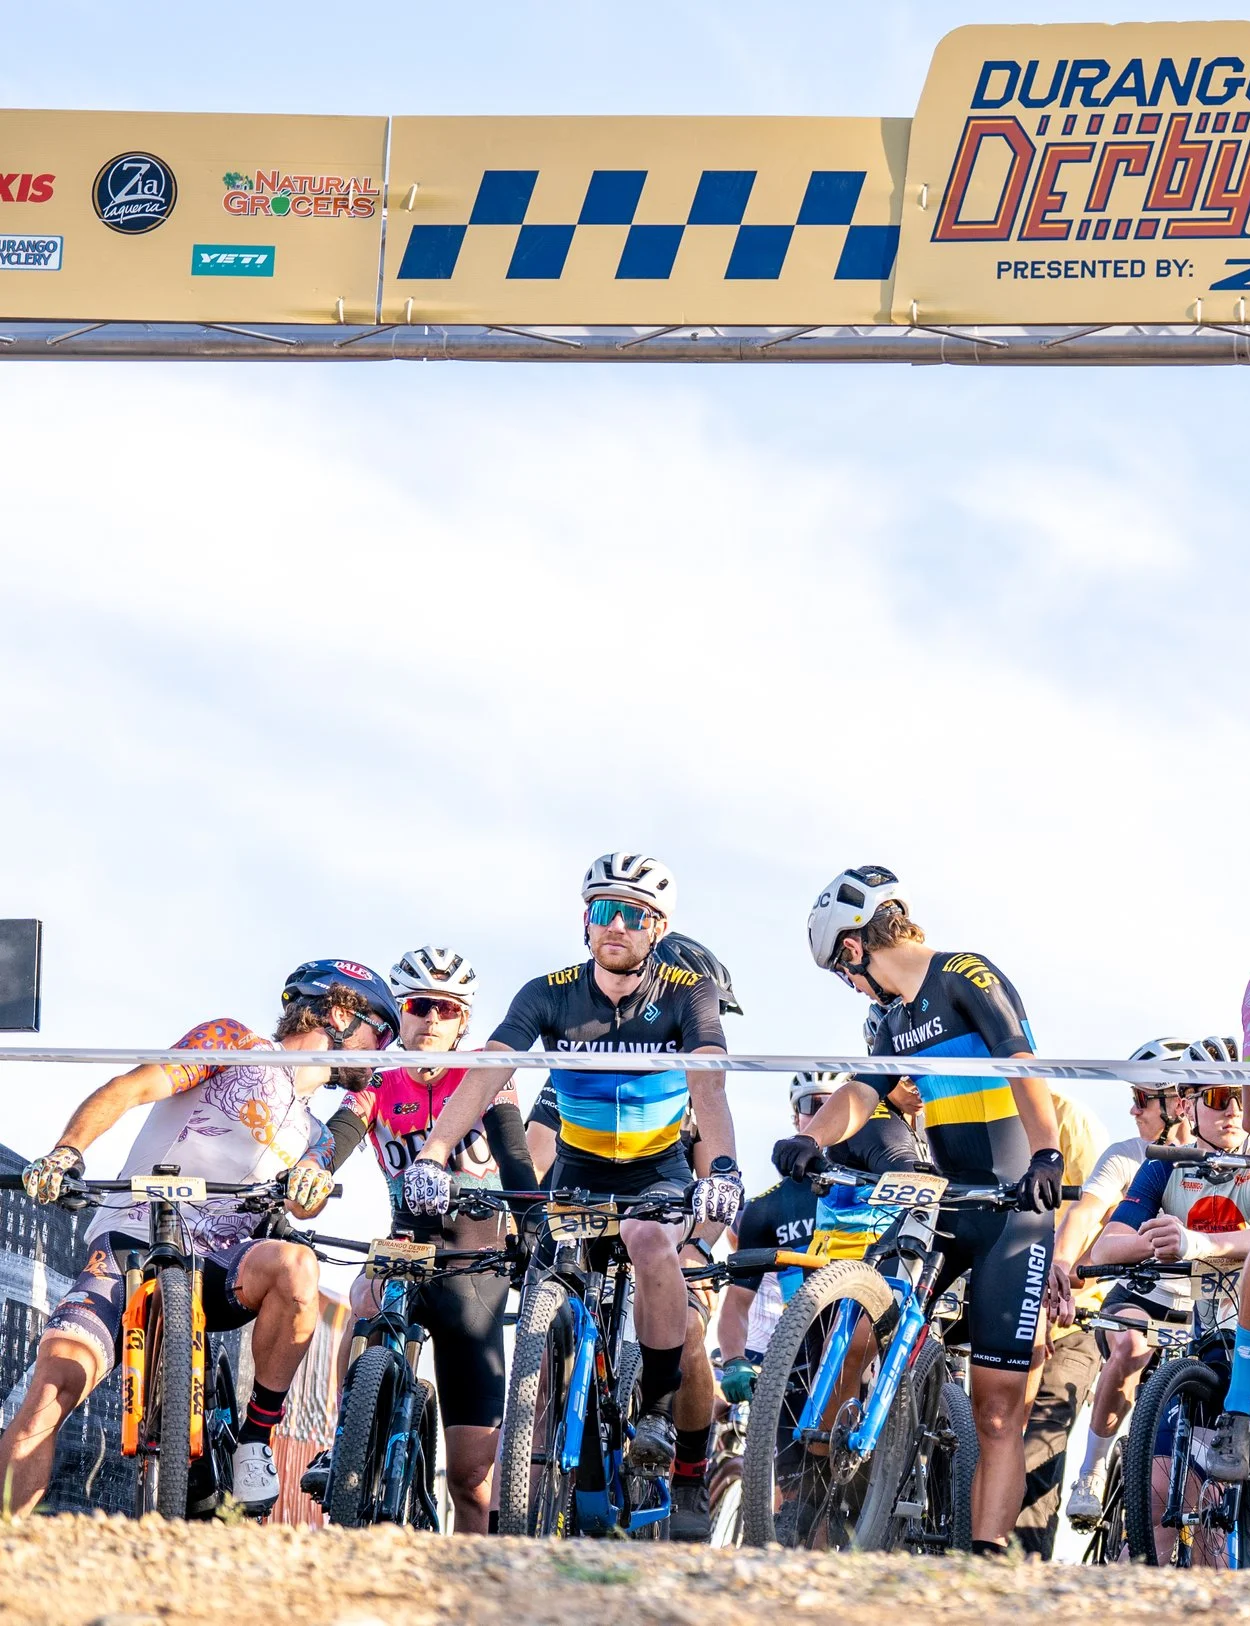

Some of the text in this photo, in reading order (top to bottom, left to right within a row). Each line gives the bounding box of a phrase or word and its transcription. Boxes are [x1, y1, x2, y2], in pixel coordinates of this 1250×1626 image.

[116, 163, 158, 201] Zia
[255, 169, 379, 195] NATURAL
[103, 198, 167, 224] taqueria
[200, 253, 269, 265] YETI
[996, 258, 1195, 280] PRESENTED BY:
[547, 965, 580, 985] FORT
[892, 1016, 943, 1053] KYHAWKS
[146, 1186, 192, 1198] 510
[878, 1184, 936, 1206] 526
[378, 1241, 407, 1249] DURANGO
[1015, 1243, 1047, 1341] DURANGO
[1201, 1272, 1240, 1293] 517
